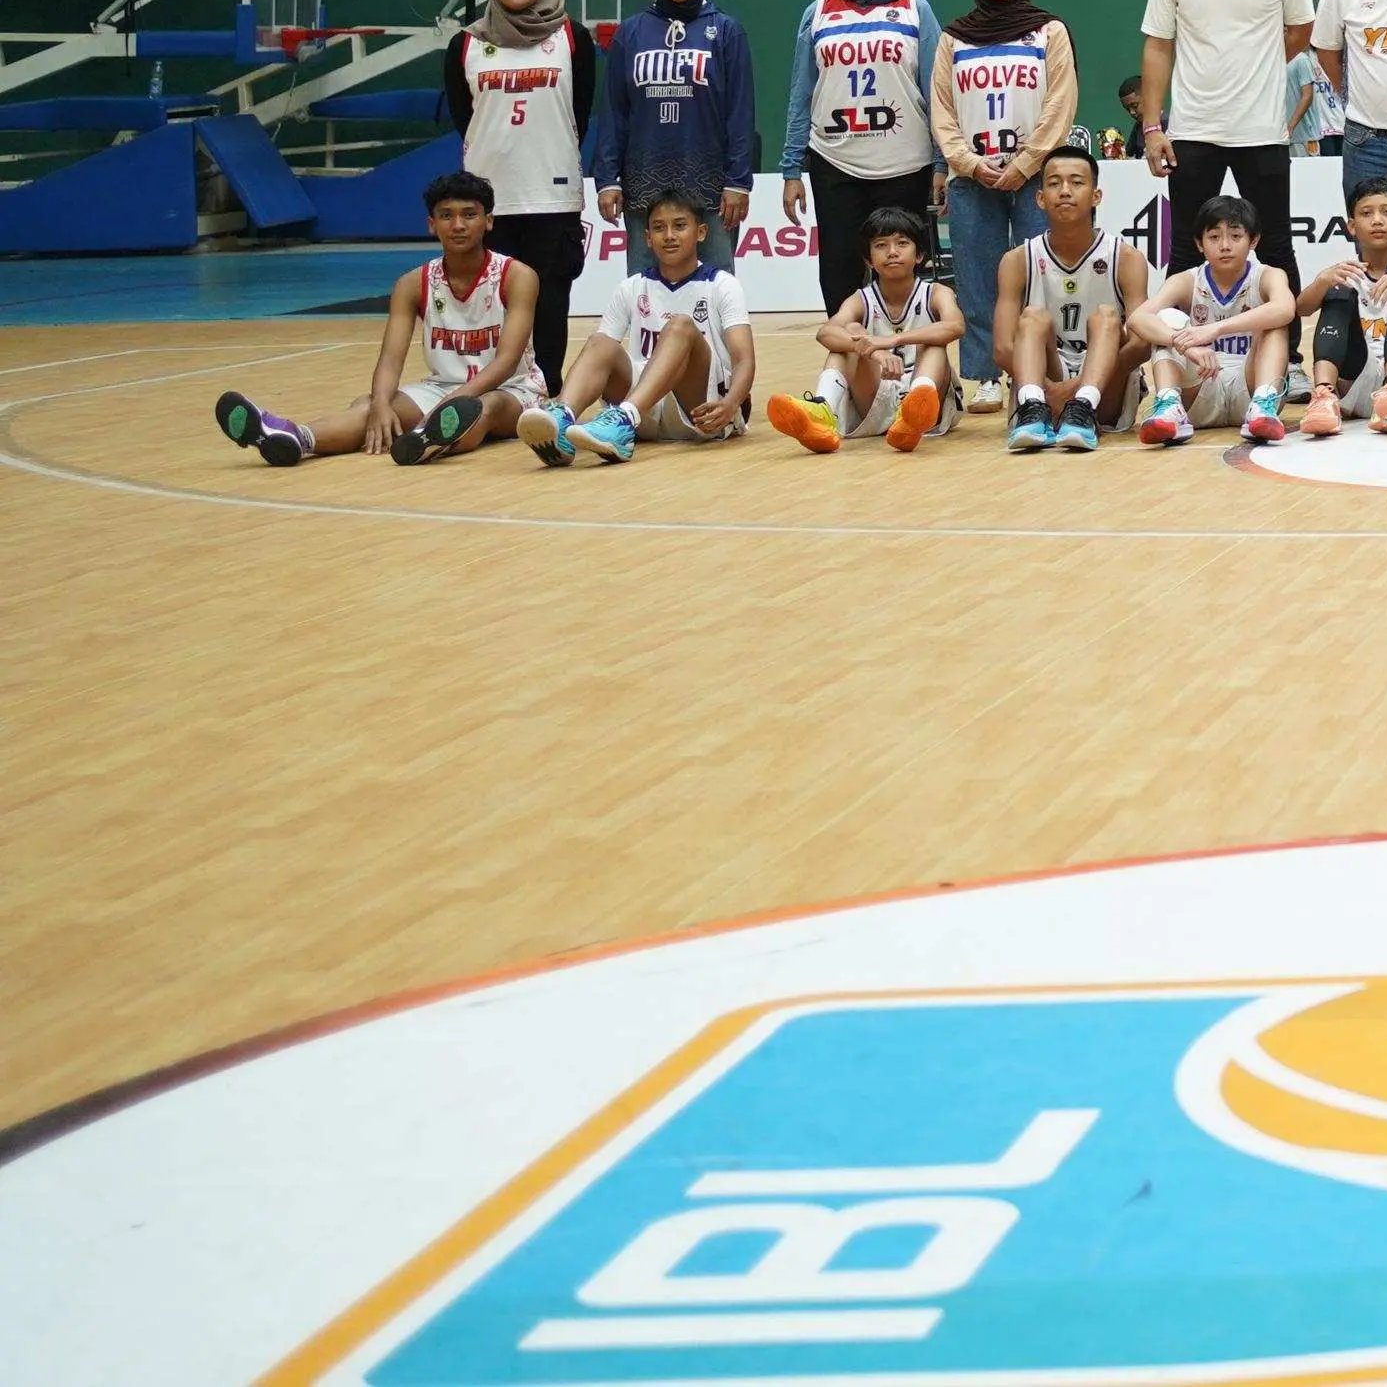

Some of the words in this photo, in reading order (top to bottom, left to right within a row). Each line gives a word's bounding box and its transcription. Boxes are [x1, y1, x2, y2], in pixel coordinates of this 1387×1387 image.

[820, 39, 904, 68] WOLVES
[847, 68, 877, 98] 12
[956, 64, 1039, 94] WOLVES
[510, 99, 528, 126] 5
[824, 105, 897, 134] SLD
[985, 93, 1006, 121] 11
[1060, 302, 1081, 332] 17
[518, 1107, 1101, 1351] IBL
